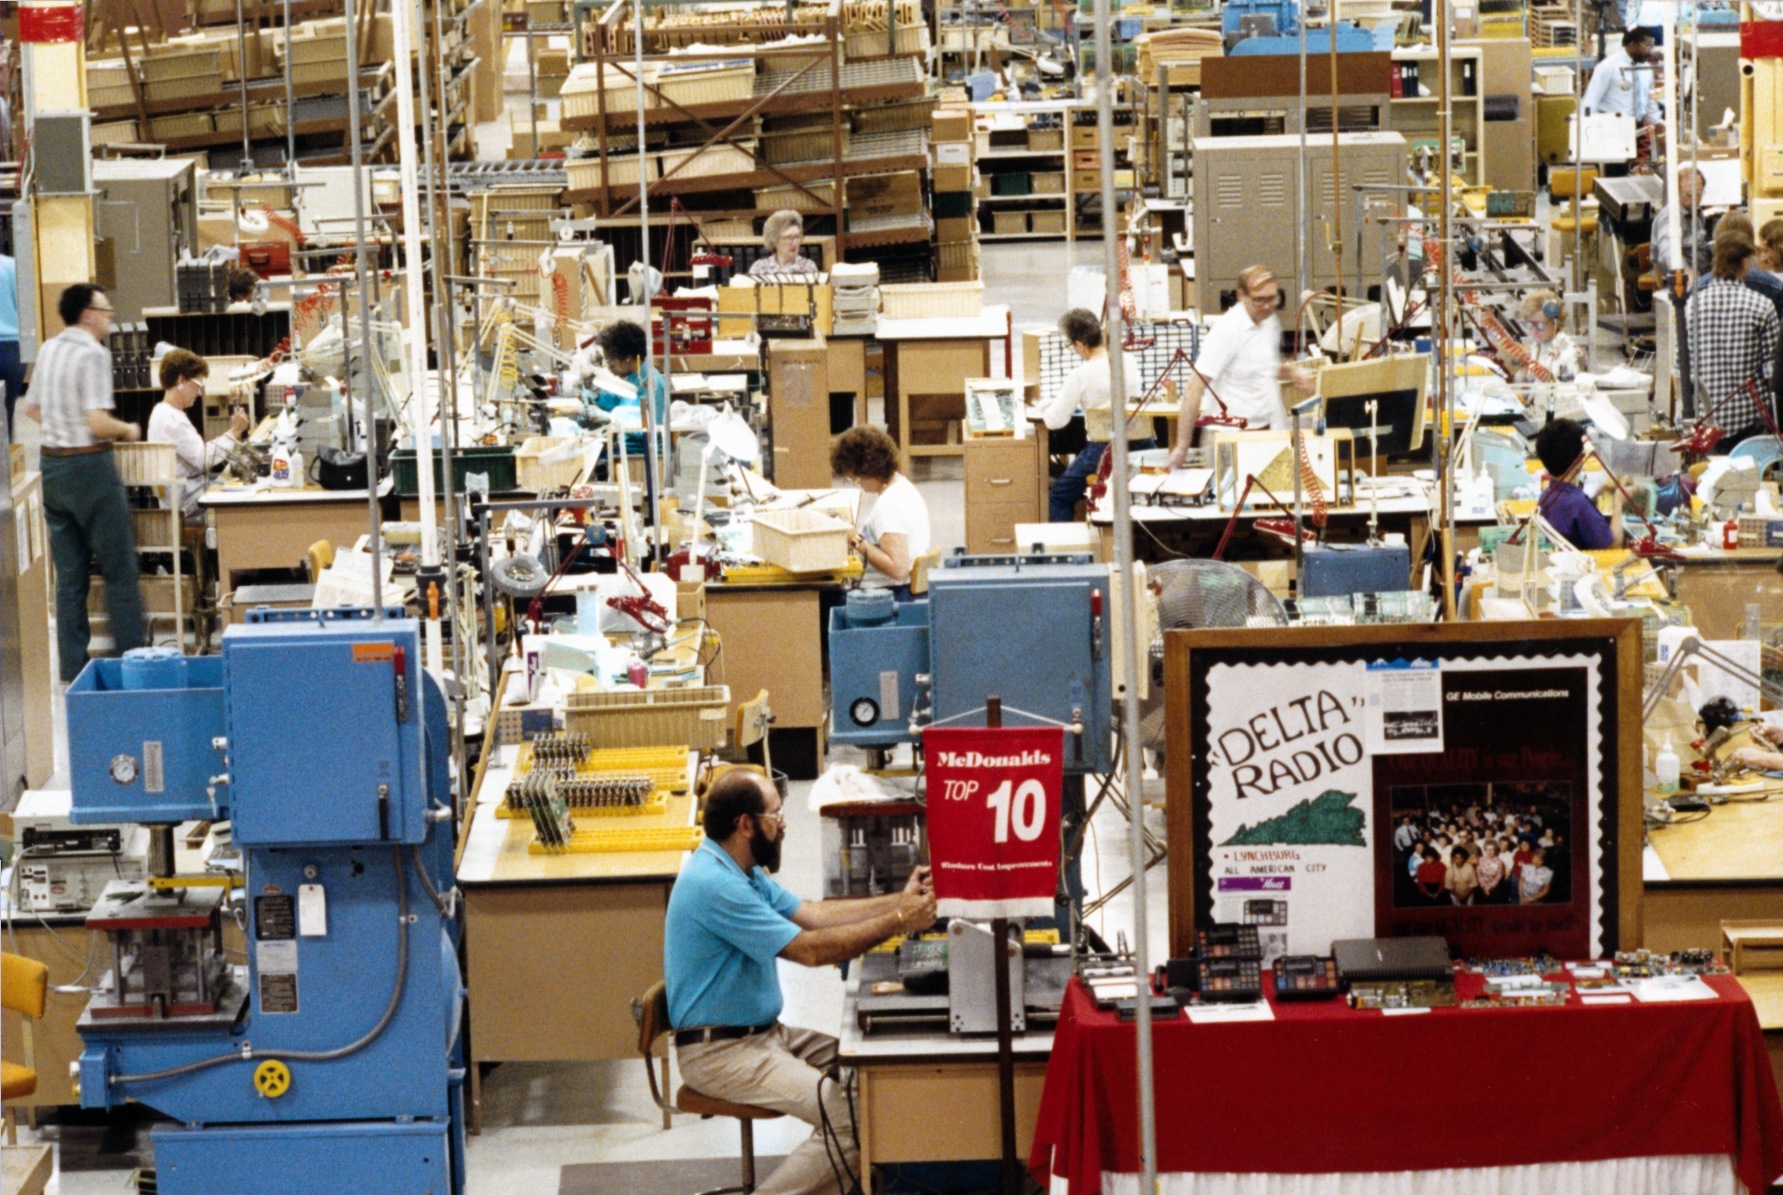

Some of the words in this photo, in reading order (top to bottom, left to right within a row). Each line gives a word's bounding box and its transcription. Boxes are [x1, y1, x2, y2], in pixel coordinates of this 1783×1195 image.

[1446, 691, 1460, 701] GE
[1462, 690, 1493, 701] Mobile
[1494, 689, 1569, 700] Communications
[937, 750, 1051, 768] McDonalds
[1231, 733, 1363, 799] RADIO
[944, 780, 979, 800] TOP
[987, 778, 1047, 843] 10
[1233, 850, 1301, 862] LYNCHBURG
[997, 860, 1053, 871] Improvements
[1225, 867, 1239, 875] ALL
[1250, 865, 1295, 873] AMERICAN
[1306, 864, 1327, 872] CITY
